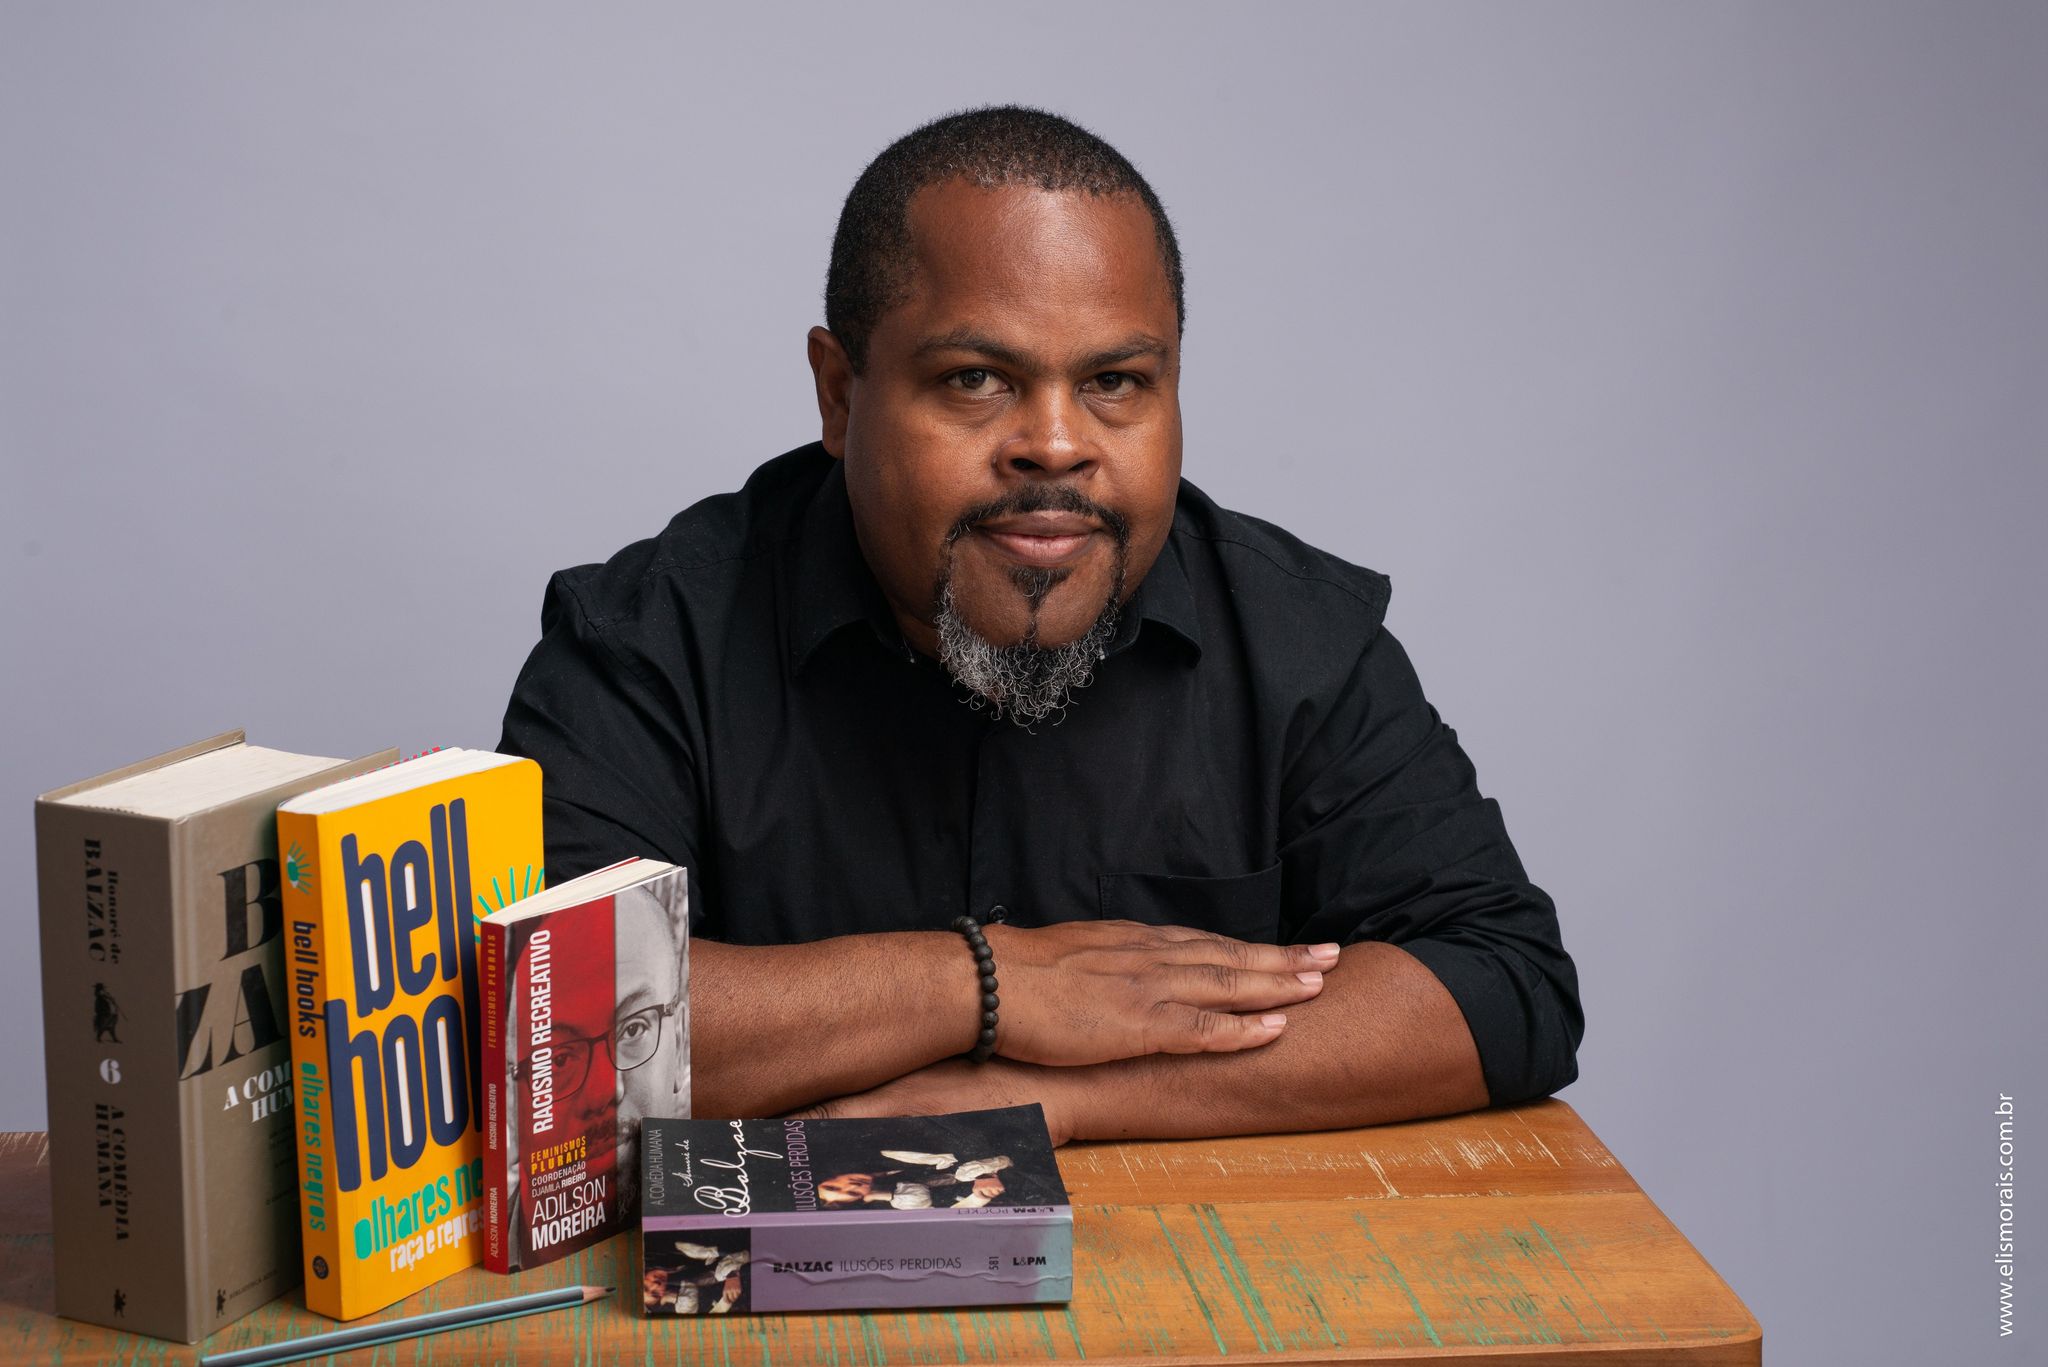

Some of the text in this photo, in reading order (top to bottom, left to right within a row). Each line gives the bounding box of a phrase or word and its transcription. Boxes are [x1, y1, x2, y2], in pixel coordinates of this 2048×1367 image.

[84, 839, 106, 962] BALZAC
[107, 870, 122, 965] Honoré de
[341, 798, 478, 1018] bell
[293, 920, 321, 1039] bell hooks
[487, 935, 496, 1048] FEMINISMOS PLURAIS
[530, 930, 554, 1134] RACISMO RECREATIVO
[100, 1058, 121, 1084] 6
[222, 1085, 239, 1111] A
[301, 1063, 324, 1149] olhares
[95, 1104, 112, 1208] HUMANA
[531, 1136, 586, 1163] FEMINISMOS
[531, 1147, 586, 1175] PLURAIS
[648, 1128, 663, 1163] HUMANA
[675, 1139, 689, 1151] de
[694, 1119, 783, 1217] Balzac
[784, 1120, 817, 1212] ILUSÕES PERDIDAS
[111, 1106, 132, 1241] A COMÉDIA
[304, 1153, 326, 1232] negros
[531, 1161, 586, 1187] COORDENAÇÃO
[531, 1171, 587, 1199] DJAMILA RIBEIRO
[646, 1163, 664, 1200] COMÉDIA
[354, 1174, 452, 1260] olhares
[489, 1187, 498, 1257] ADILSON MOREIRA
[532, 1175, 606, 1226] ADILSON
[957, 1207, 1009, 1215] POCKET
[532, 1202, 606, 1251] MOREIRA
[390, 1233, 425, 1272] raça
[426, 1232, 436, 1255] e
[773, 1256, 962, 1273] BALZAC ILUSÕES PERDIDAS
[988, 1256, 1000, 1271] 581
[1012, 1256, 1047, 1266] L&PM
